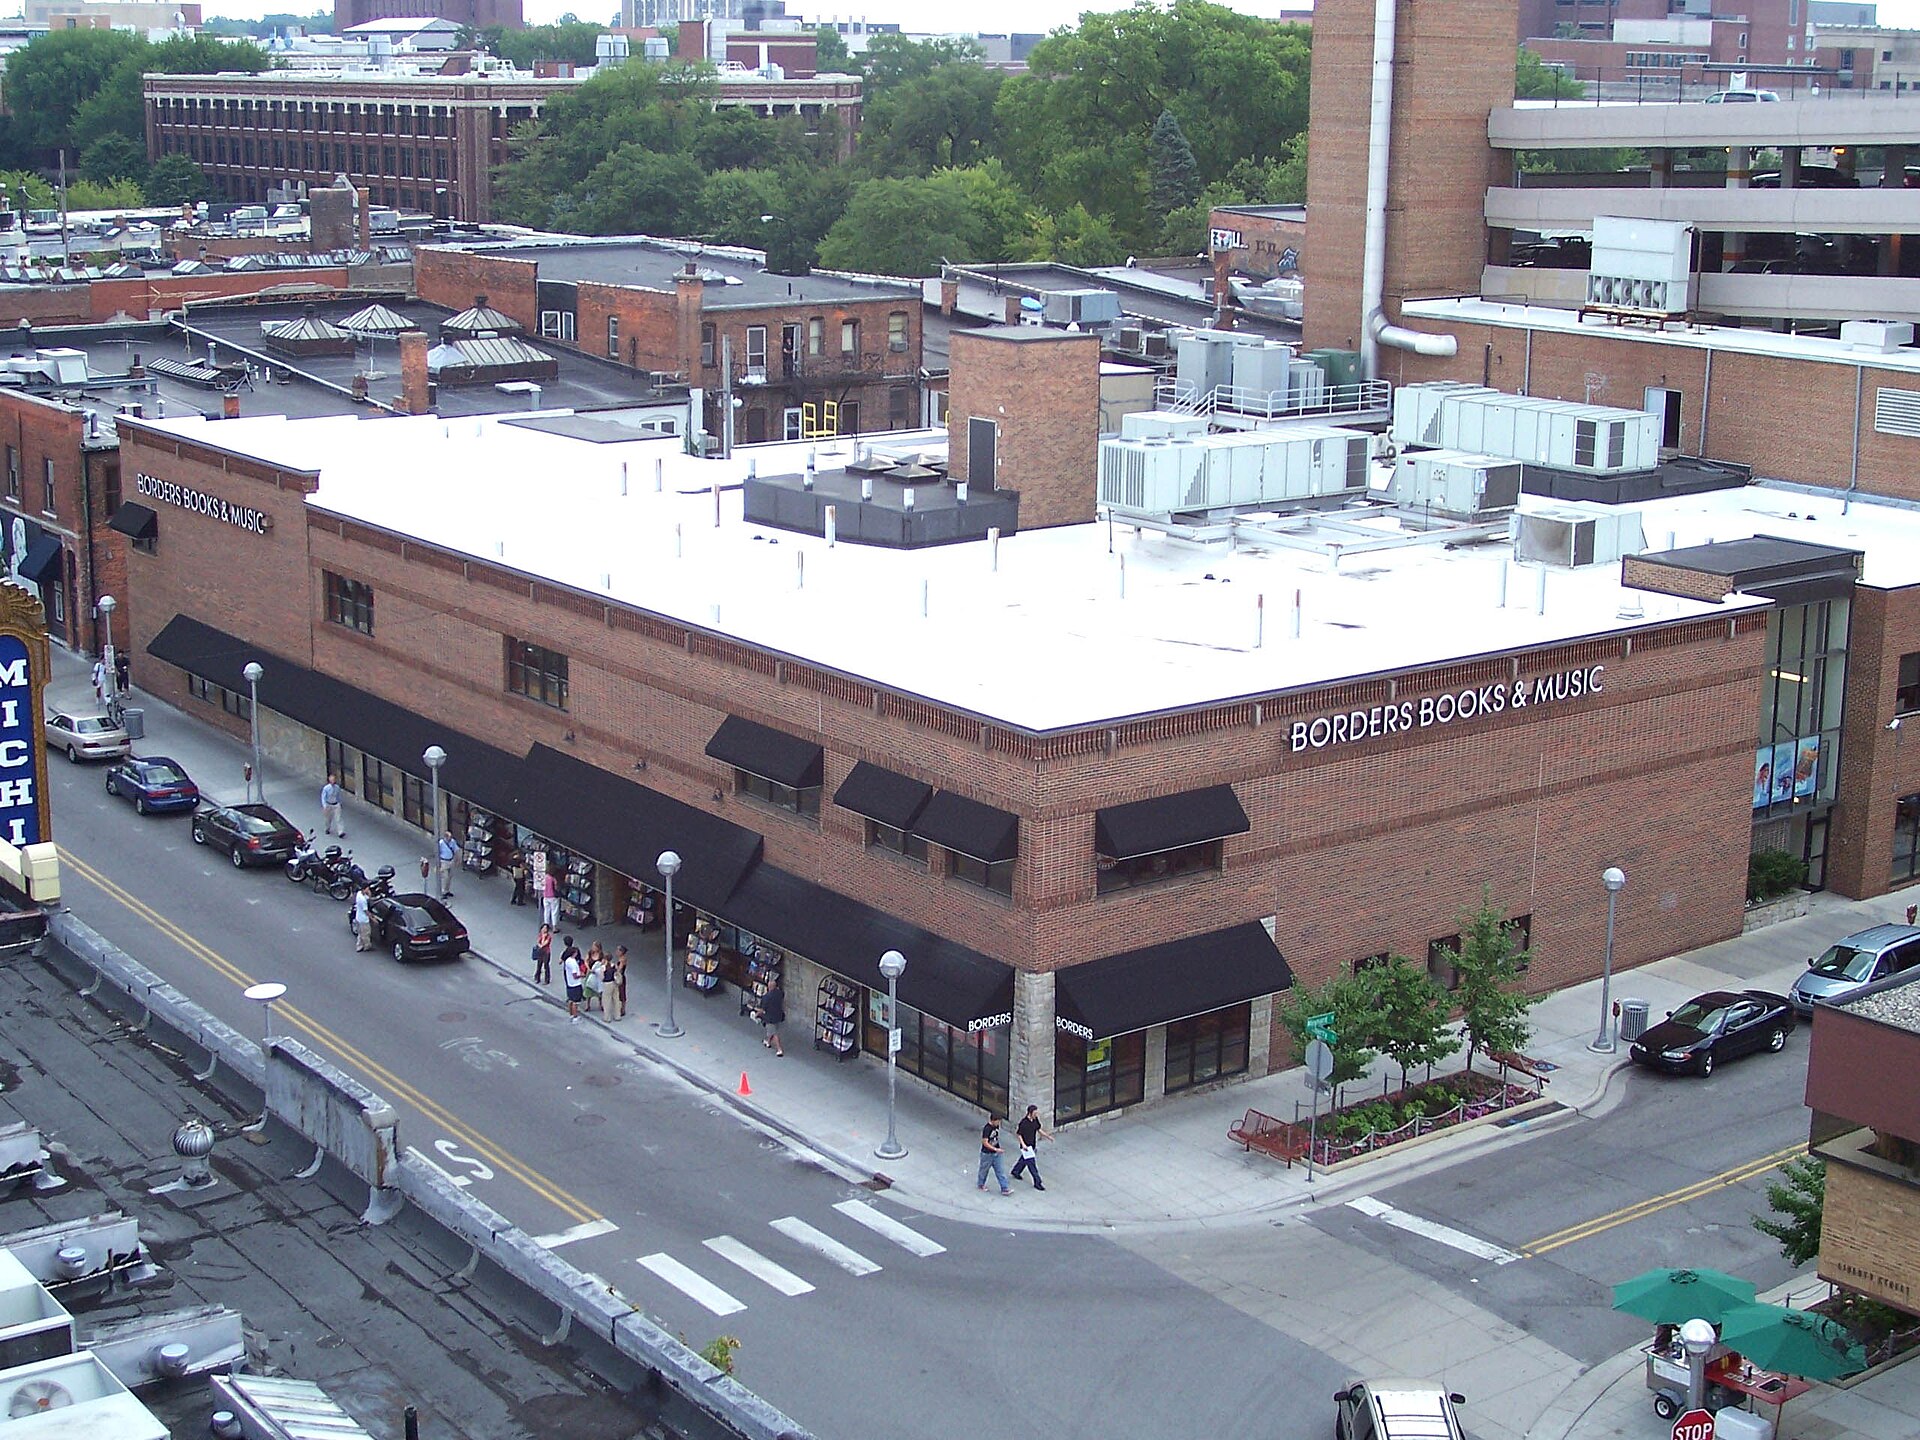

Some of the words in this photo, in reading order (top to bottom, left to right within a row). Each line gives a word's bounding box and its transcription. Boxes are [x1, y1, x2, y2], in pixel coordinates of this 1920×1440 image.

[137, 473, 182, 507] BORDERS
[183, 488, 220, 519] BOOKS
[220, 500, 230, 522] &
[231, 505, 265, 535] MUSIC
[1290, 701, 1413, 752] BORDERS
[1418, 682, 1507, 727] BOOKS
[1510, 679, 1528, 709] &
[1533, 664, 1606, 705] MUSIC
[967, 1012, 1012, 1033] BORDERS
[1055, 1015, 1094, 1041] BORDERS
[1675, 1422, 1713, 1440] STOP
